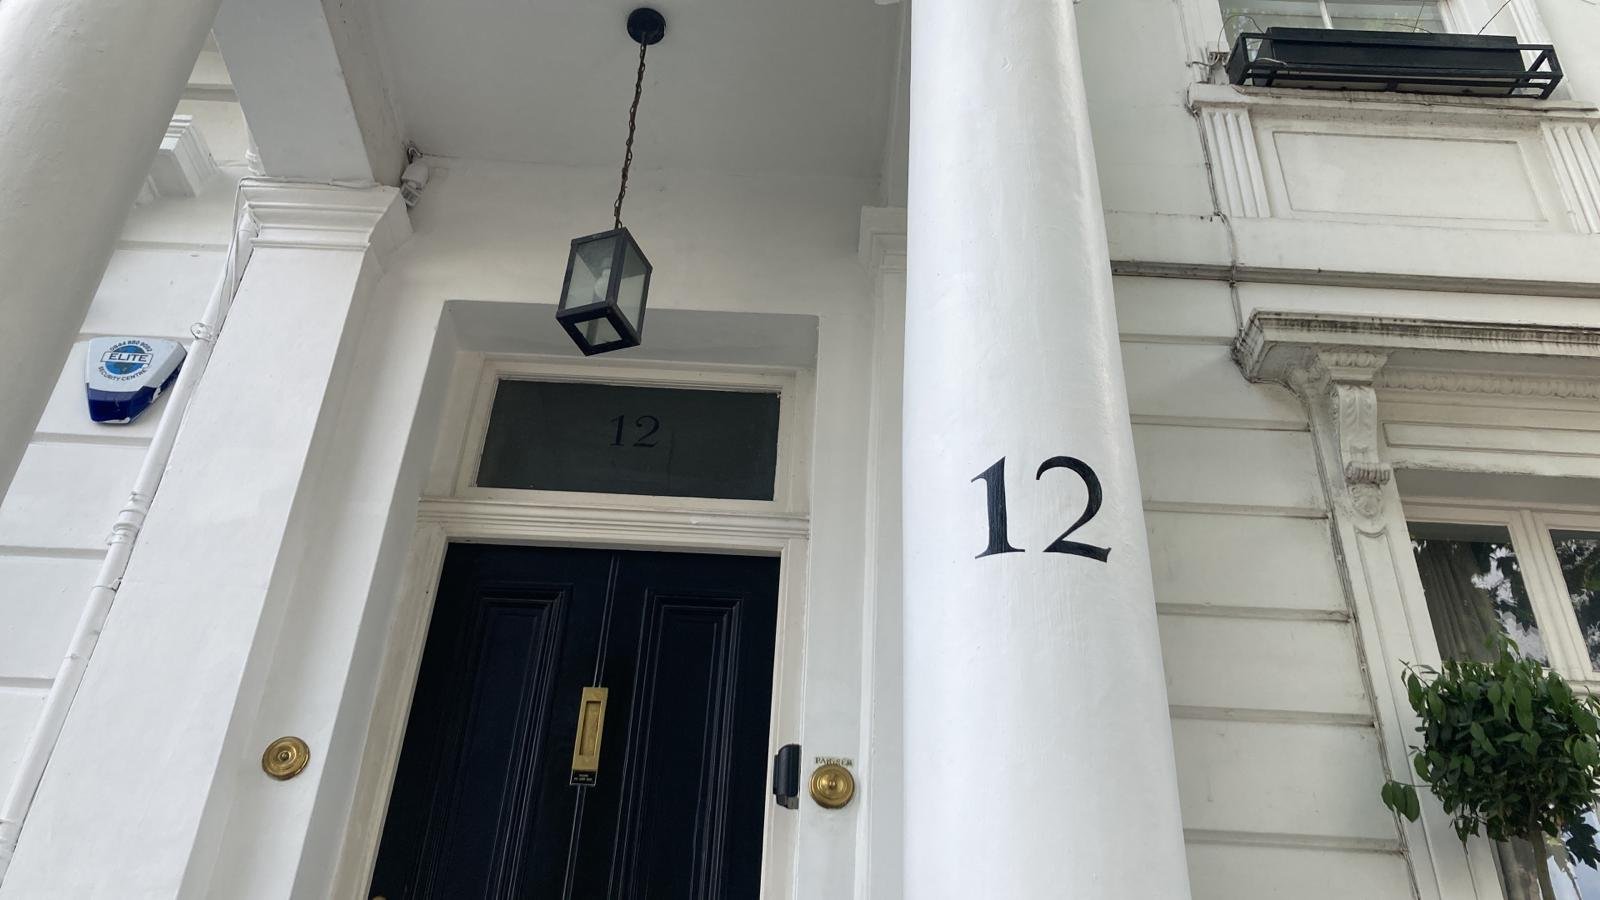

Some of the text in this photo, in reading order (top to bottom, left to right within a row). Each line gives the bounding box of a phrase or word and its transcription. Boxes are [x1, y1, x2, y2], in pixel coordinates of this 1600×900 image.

[108, 352, 149, 362] ELITE
[98, 366, 147, 381] SECURITY CENTRE
[610, 414, 660, 447] 12
[971, 456, 1112, 563] 12
